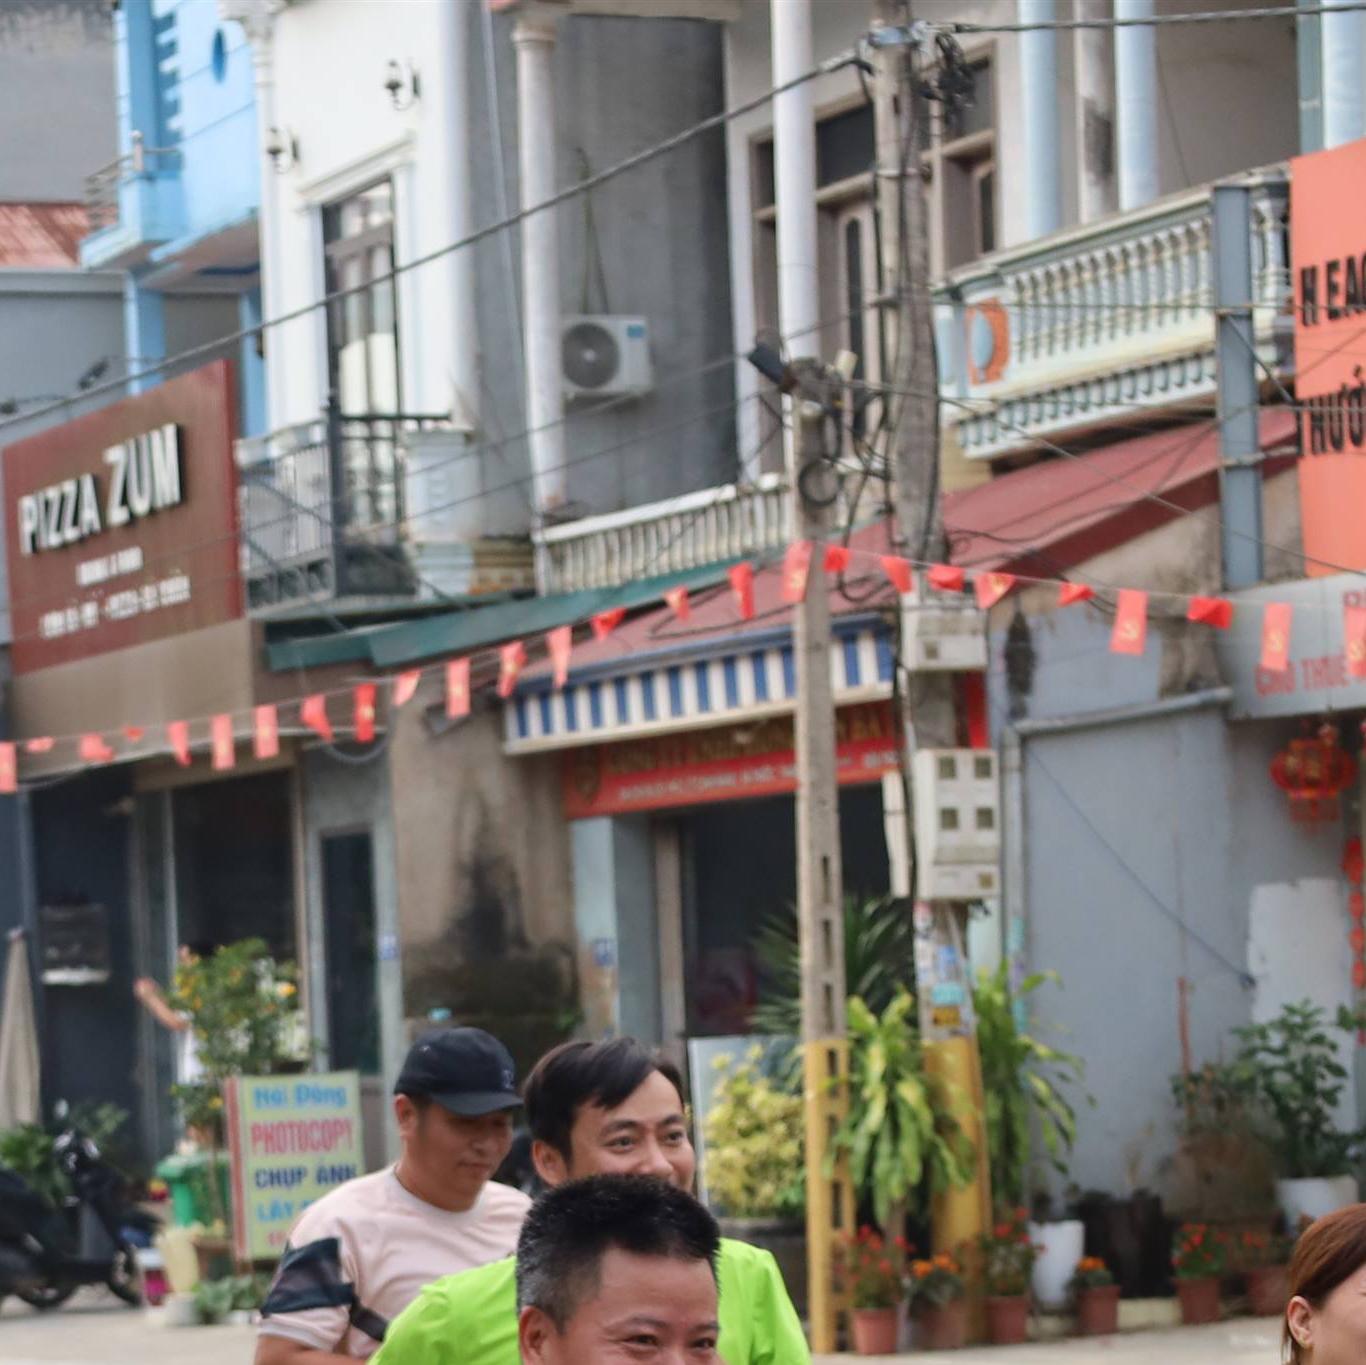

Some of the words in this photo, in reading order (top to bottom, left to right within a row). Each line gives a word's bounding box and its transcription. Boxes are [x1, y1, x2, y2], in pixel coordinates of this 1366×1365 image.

[18, 473, 102, 559] PIZZA
[102, 422, 183, 529] ZUM
[250, 1118, 354, 1155] PHOTOCOPY
